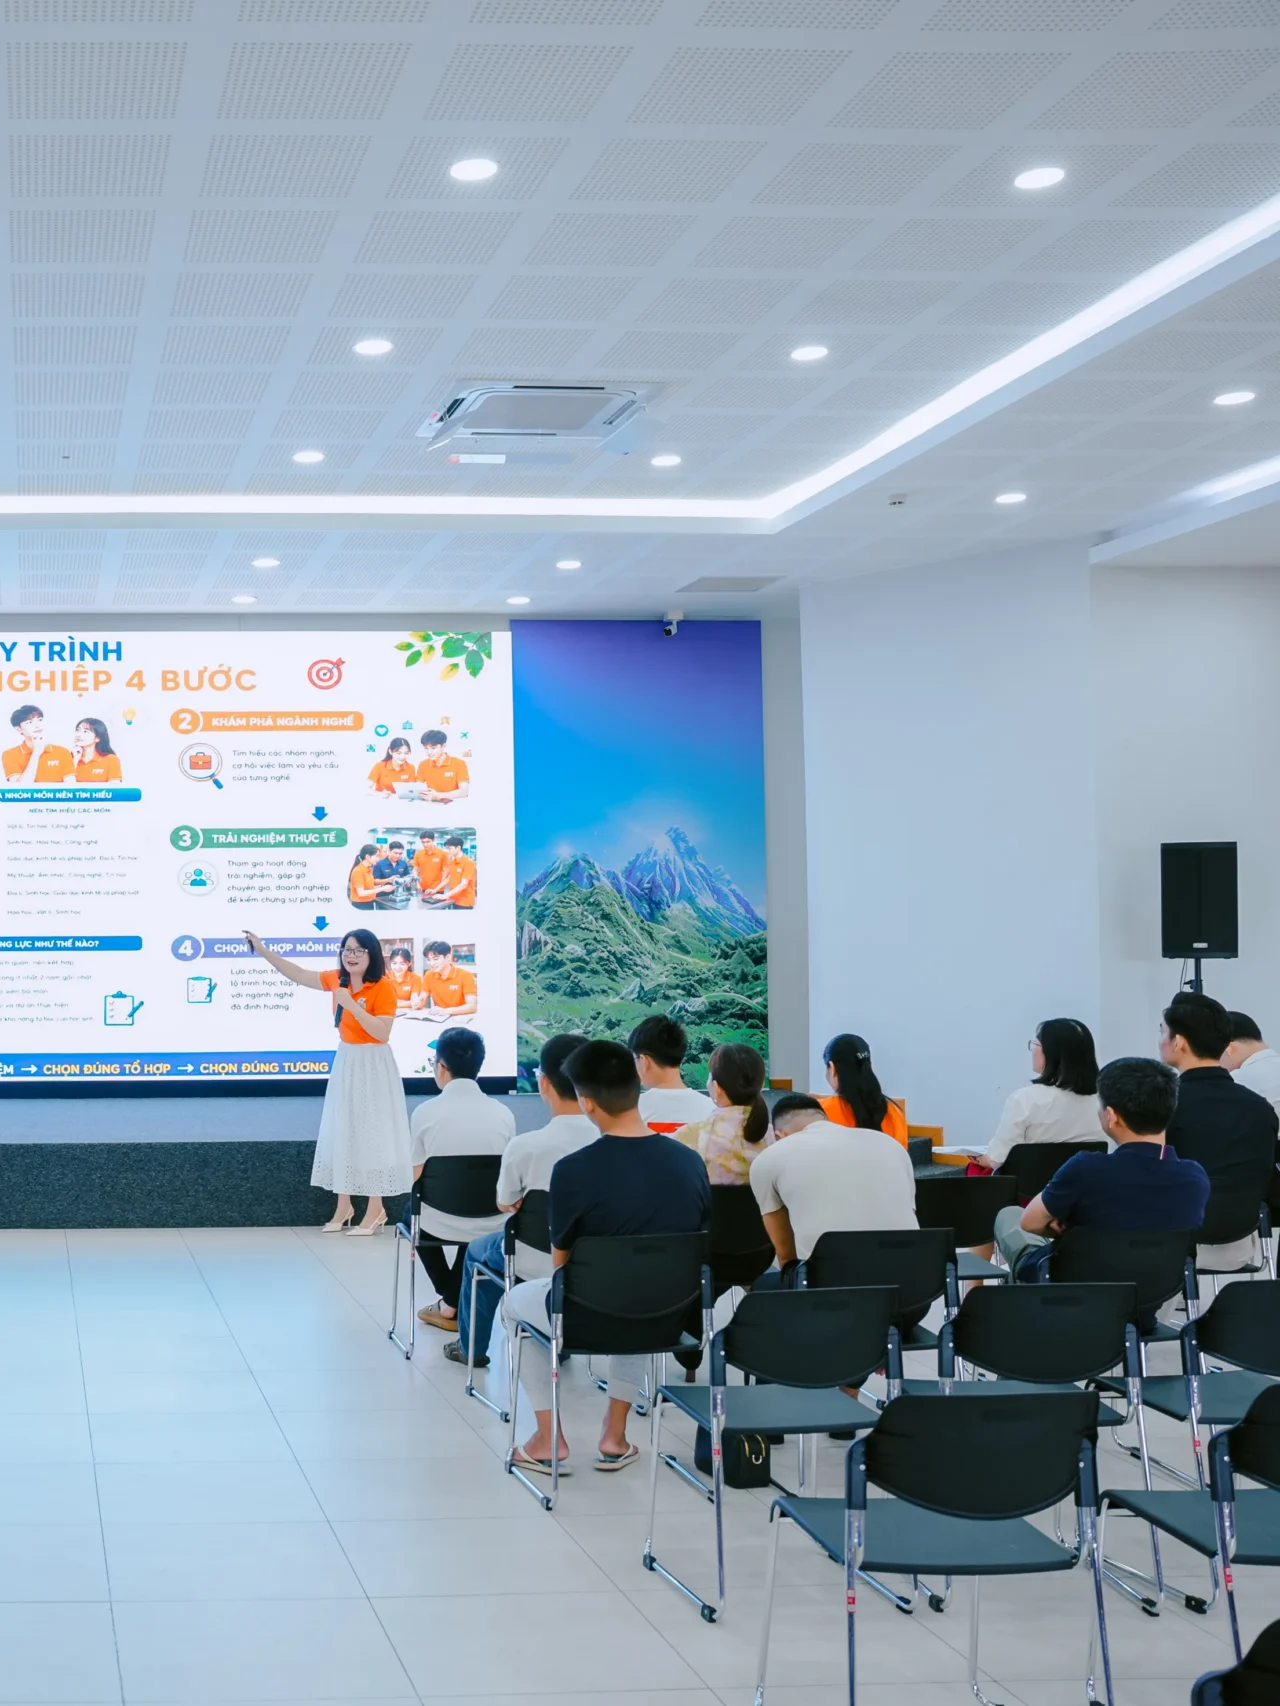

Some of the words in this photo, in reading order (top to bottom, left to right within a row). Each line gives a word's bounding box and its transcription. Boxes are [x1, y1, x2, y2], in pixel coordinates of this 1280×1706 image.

[29, 636, 123, 662] TRÌNH
[125, 669, 147, 692] 4
[161, 665, 257, 692] BƯỚC
[178, 712, 193, 730] 2
[212, 715, 246, 726] KHÁM
[250, 715, 273, 726] PHÁ
[277, 715, 318, 726] NGÀNH
[322, 713, 354, 726] NGHỀ
[5, 791, 31, 799] NHÓM
[34, 790, 54, 799] MÔN
[56, 790, 73, 799] NÊN
[76, 791, 90, 799] TÌM
[178, 829, 192, 846] 3
[212, 831, 237, 843] TRẢI
[241, 831, 285, 845] NGHIỆM
[289, 833, 319, 845] THỰC
[323, 831, 336, 843] TẾ
[15, 940, 32, 949] LỰC
[35, 940, 54, 948] NHƯ
[57, 938, 72, 948] THẾ
[75, 939, 99, 948] NÀO?
[178, 940, 194, 957] 4
[214, 943, 248, 955] CHỌN
[269, 943, 293, 954] HỢP
[296, 941, 323, 952] MÔN
[43, 1064, 80, 1076] CHỌN
[83, 1062, 120, 1074] ĐÚNG
[123, 1060, 141, 1074] TỔ
[144, 1063, 171, 1076] HỢP
[200, 1063, 237, 1075] CHỌN
[242, 1061, 279, 1073] ĐÚNG
[282, 1061, 329, 1073] TƯƠNG
